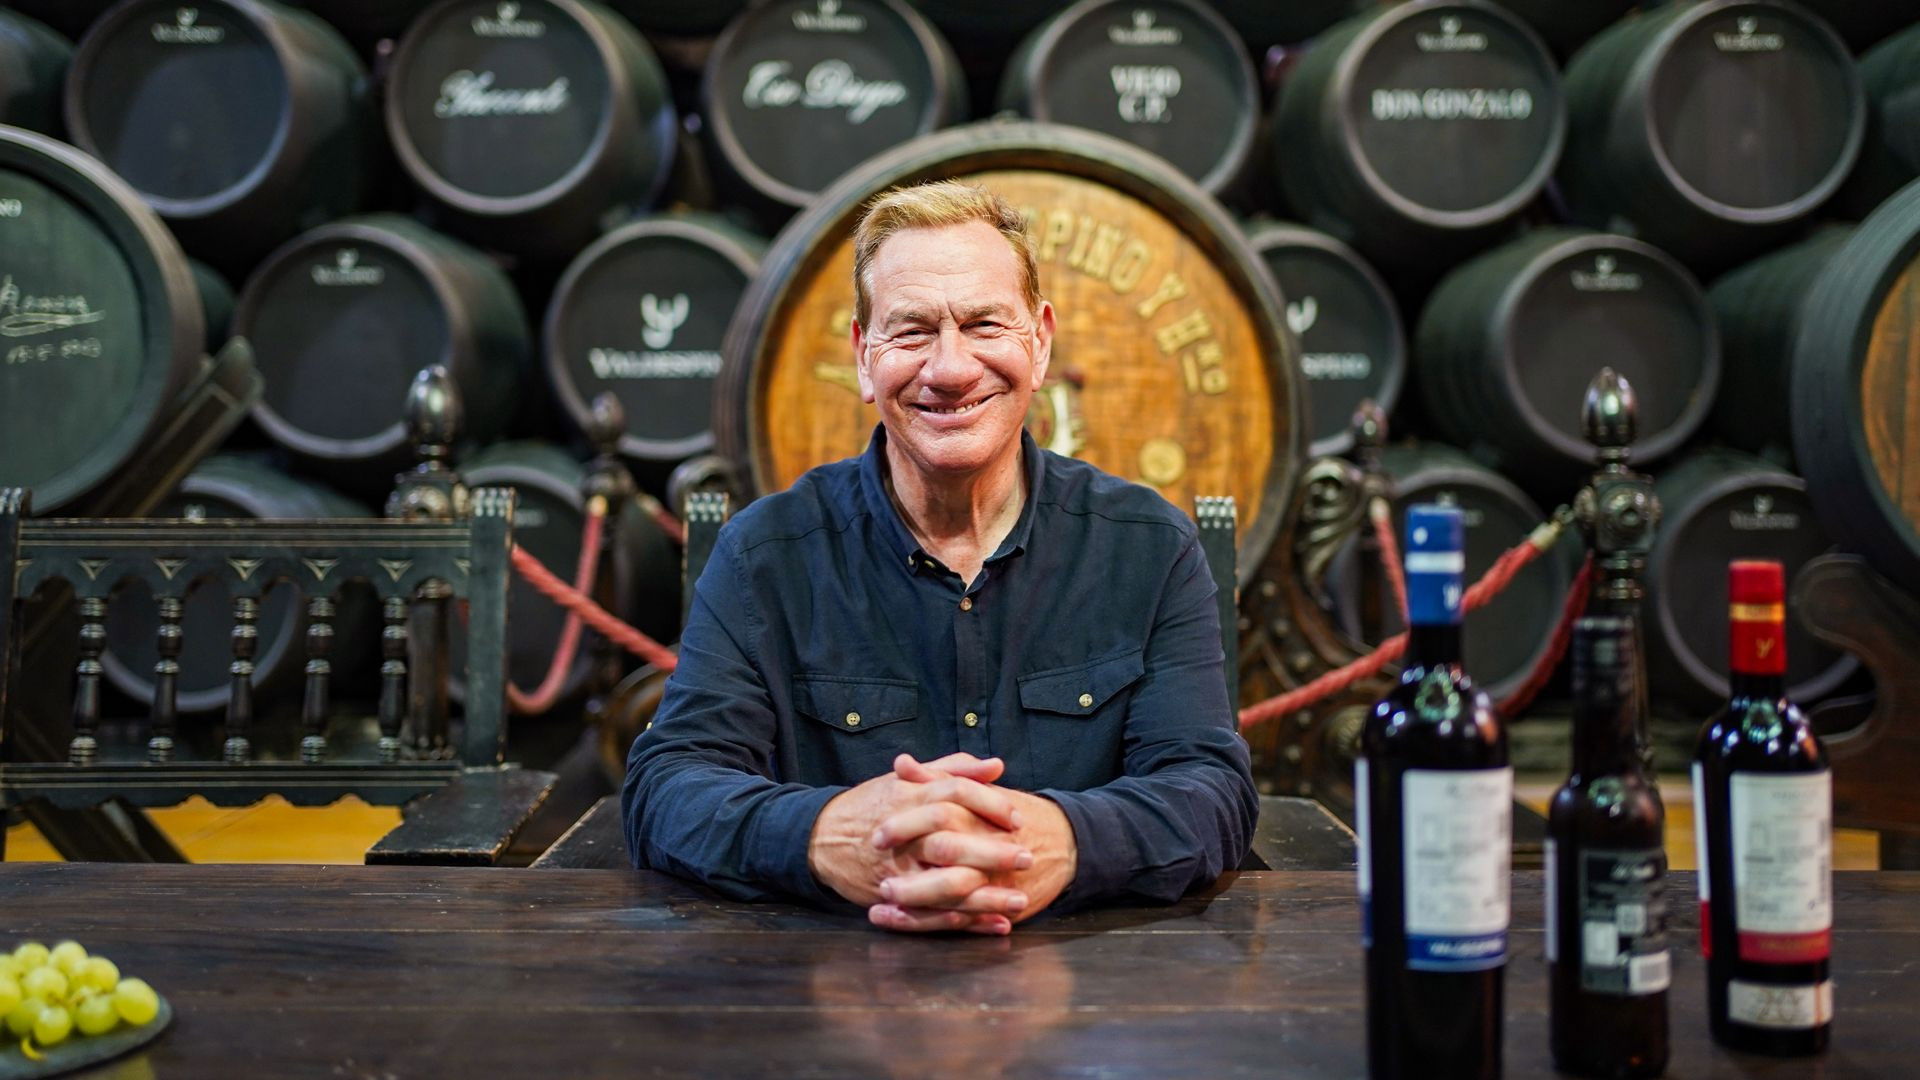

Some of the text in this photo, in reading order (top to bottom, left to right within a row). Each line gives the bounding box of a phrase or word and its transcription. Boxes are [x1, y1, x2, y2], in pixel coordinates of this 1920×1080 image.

[1372, 87, 1532, 120] DON GONZALO
[1136, 272, 1187, 310] Y
